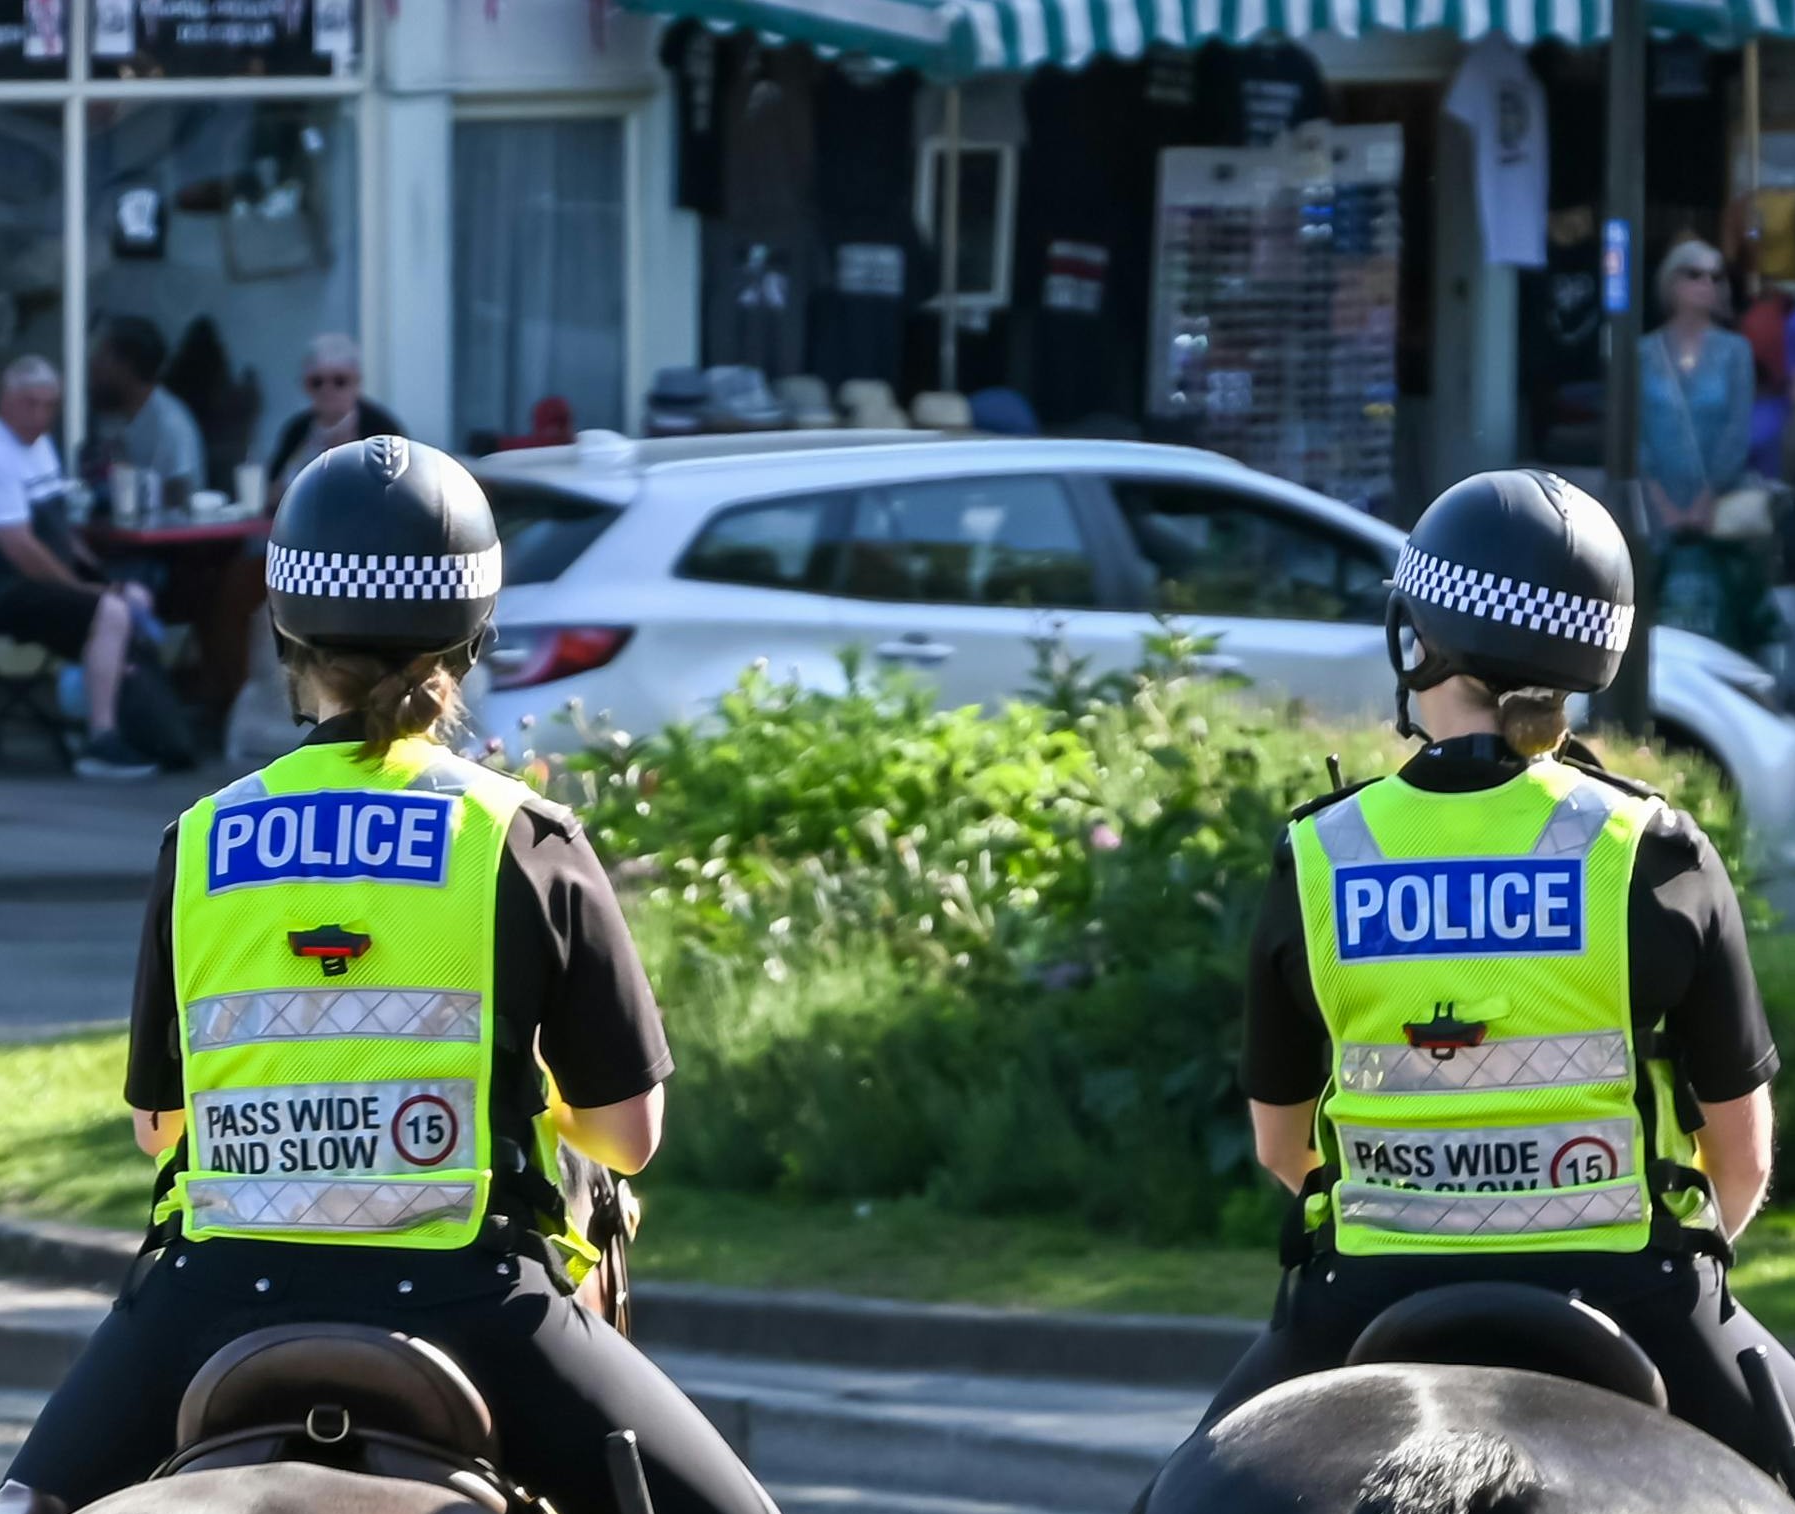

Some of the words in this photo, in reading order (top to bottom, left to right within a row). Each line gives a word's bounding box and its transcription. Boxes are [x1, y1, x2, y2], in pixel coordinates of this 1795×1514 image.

[215, 804, 439, 877] POLICE
[1345, 872, 1572, 946] POLICE
[206, 1100, 281, 1139] PASS
[287, 1096, 381, 1134] WIDE
[405, 1114, 445, 1146] 15
[210, 1140, 270, 1175] AND
[279, 1135, 379, 1173] SLOW
[1354, 1141, 1436, 1178] PASS
[1443, 1140, 1540, 1178] WIDE
[1566, 1154, 1604, 1186] 15
